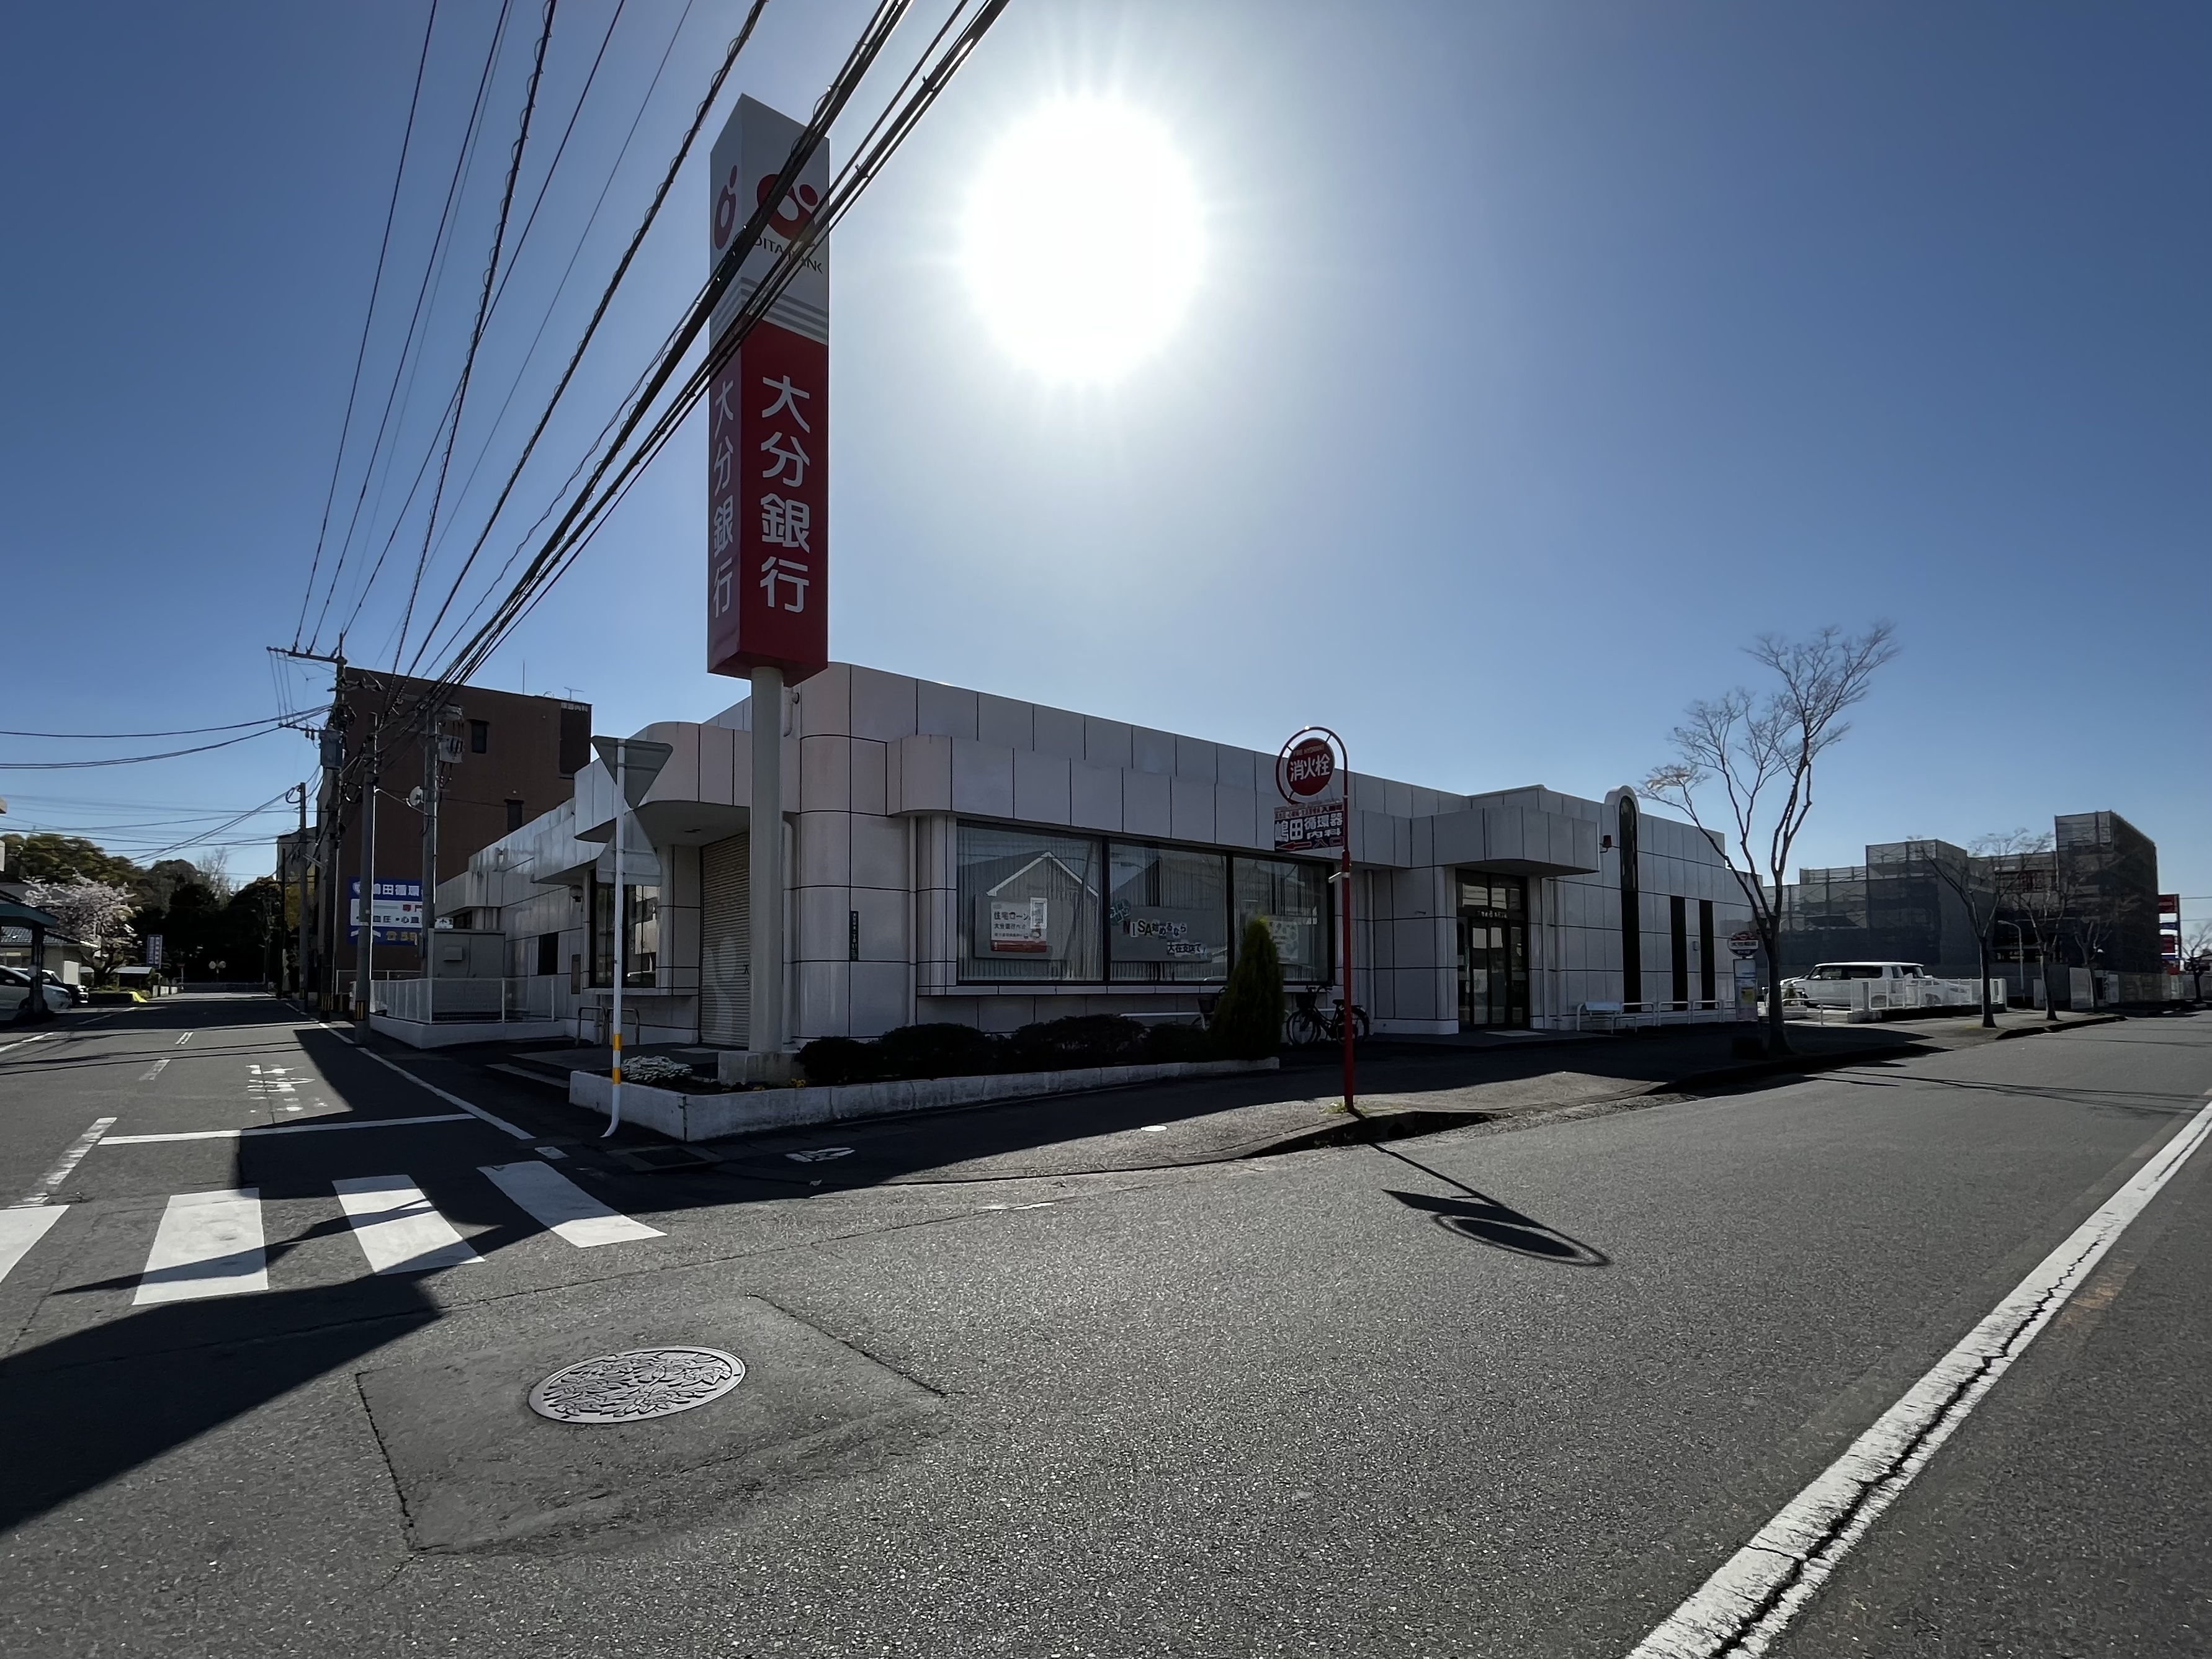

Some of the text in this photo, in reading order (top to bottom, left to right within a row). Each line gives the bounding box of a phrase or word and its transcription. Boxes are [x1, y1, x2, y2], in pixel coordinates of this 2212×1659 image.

[713, 379, 733, 618] 大分銀行
[760, 375, 810, 613] 大分銀行
[1290, 753, 1330, 782] 消火栓
[1312, 836, 1344, 849] 入口
